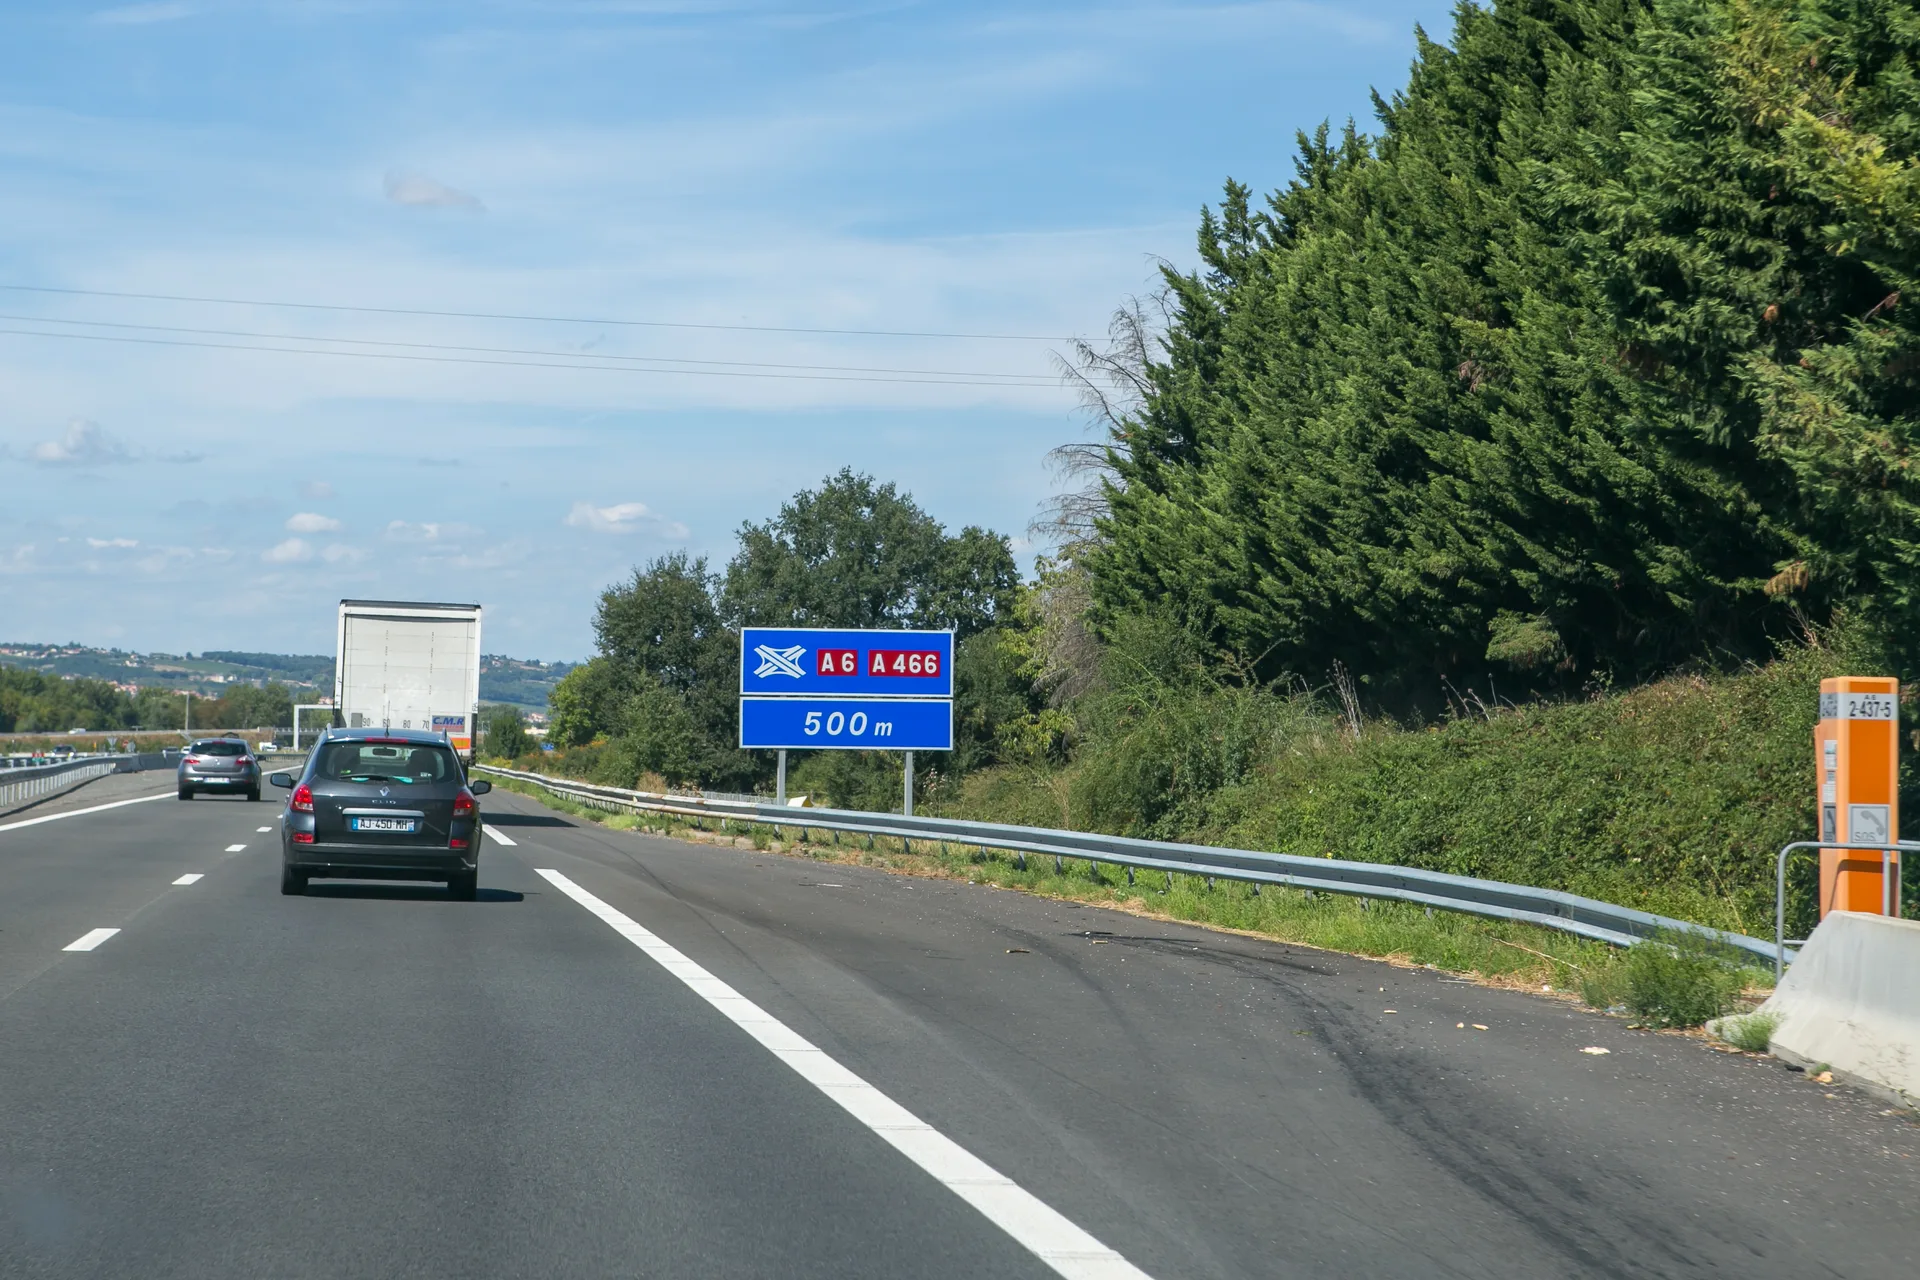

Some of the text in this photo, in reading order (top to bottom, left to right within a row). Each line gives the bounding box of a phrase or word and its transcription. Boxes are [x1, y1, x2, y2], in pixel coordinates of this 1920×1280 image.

[821, 652, 855, 673] A 6
[872, 653, 937, 674] A 466
[1849, 700, 1891, 718] 2-437-5
[804, 711, 893, 737] 500 m
